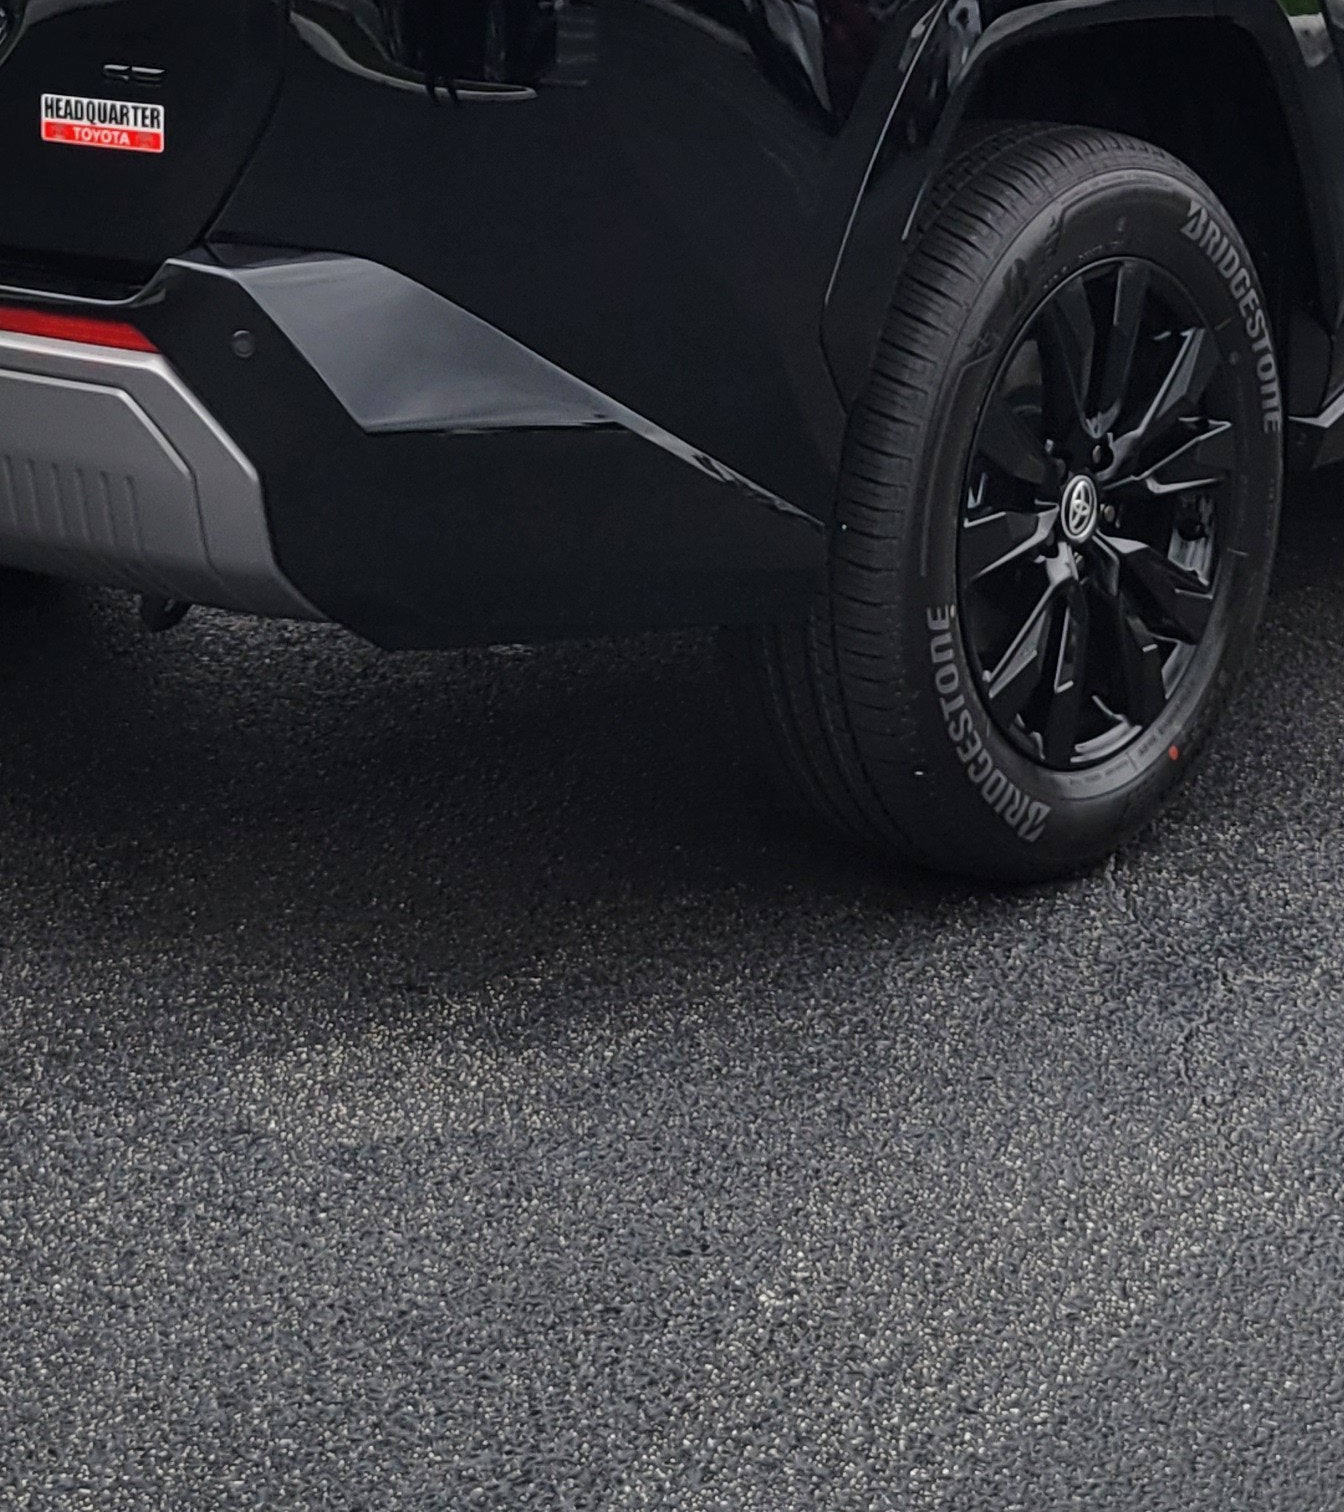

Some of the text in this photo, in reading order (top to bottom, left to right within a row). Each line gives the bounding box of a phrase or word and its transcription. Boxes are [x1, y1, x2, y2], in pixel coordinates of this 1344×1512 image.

[44, 96, 161, 130] HEADQUARTER
[73, 126, 131, 146] TOYOTA
[1179, 200, 1283, 434] BRIDGESTONE
[927, 604, 1052, 843] BRIDGESTONE
